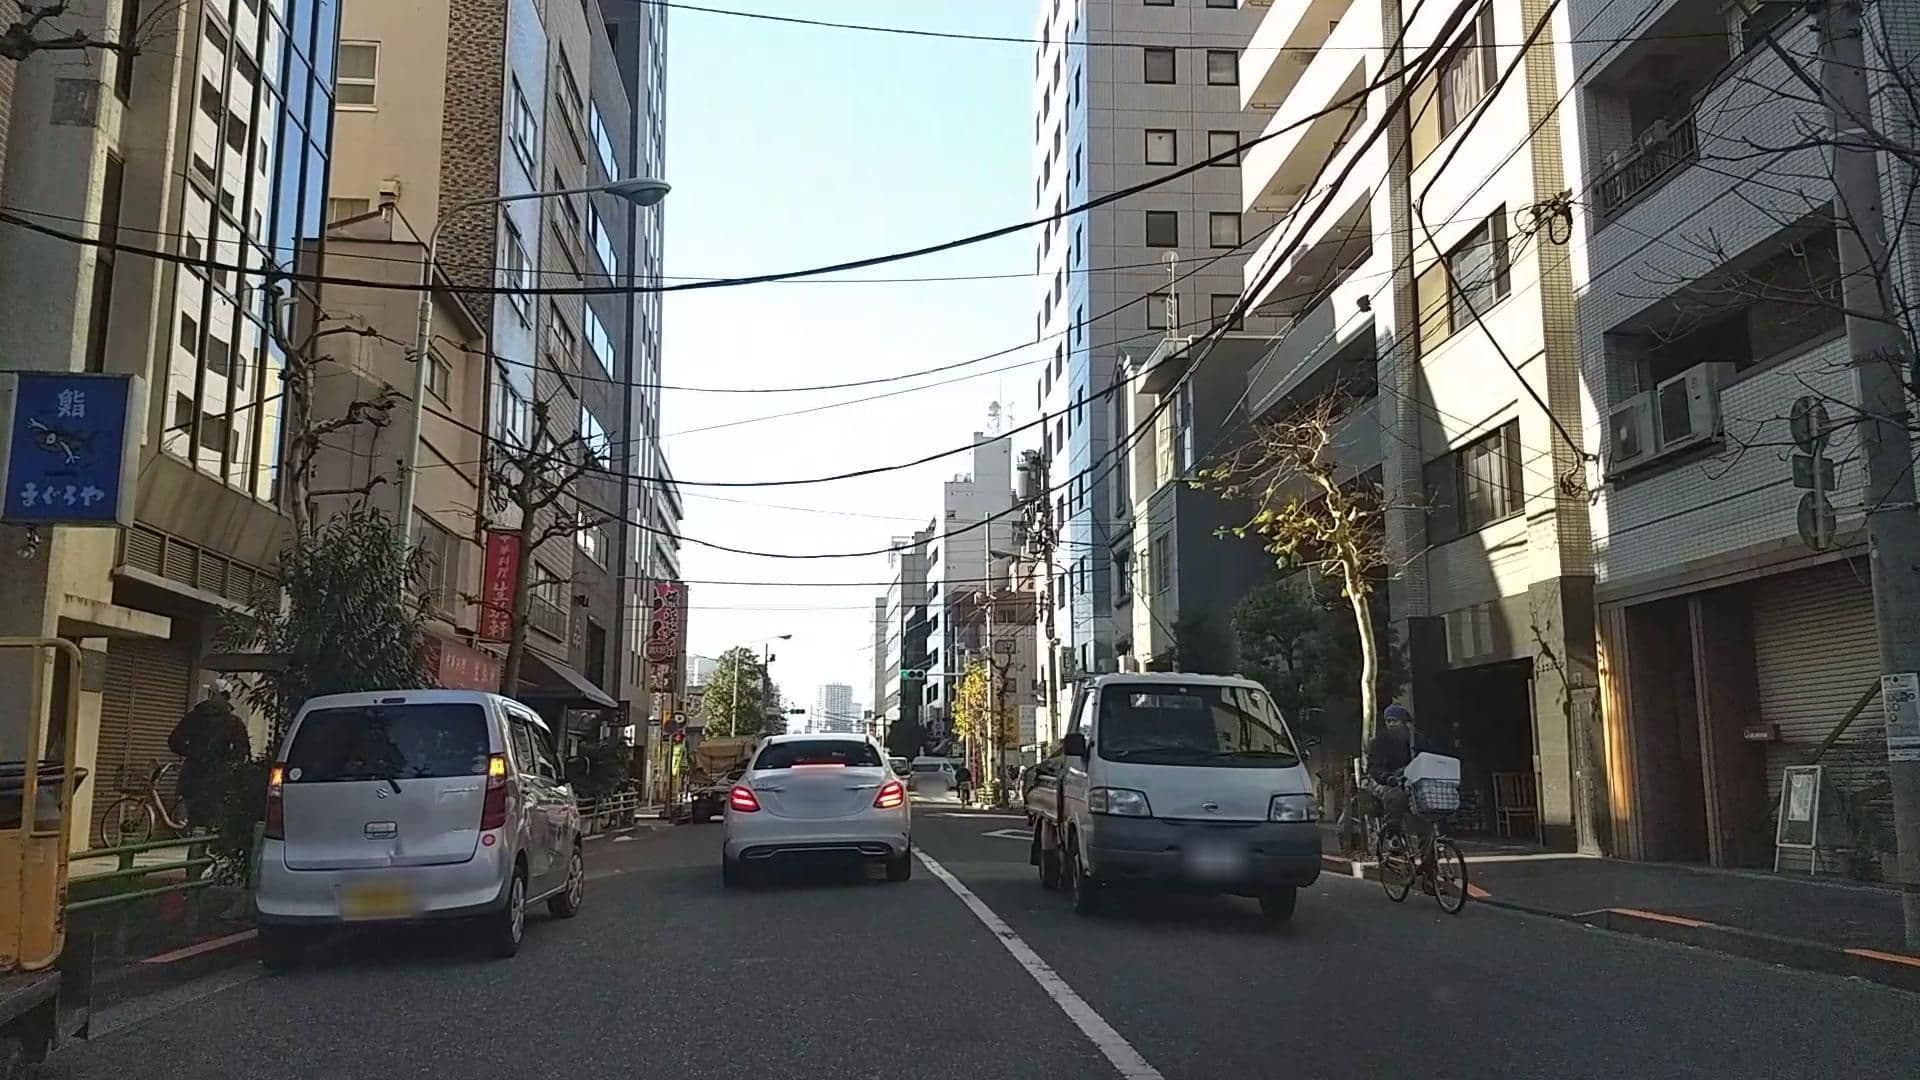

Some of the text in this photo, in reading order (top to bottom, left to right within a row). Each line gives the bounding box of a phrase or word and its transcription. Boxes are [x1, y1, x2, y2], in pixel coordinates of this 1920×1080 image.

[58, 388, 86, 418] 鮨
[21, 482, 105, 507] まぐろや
